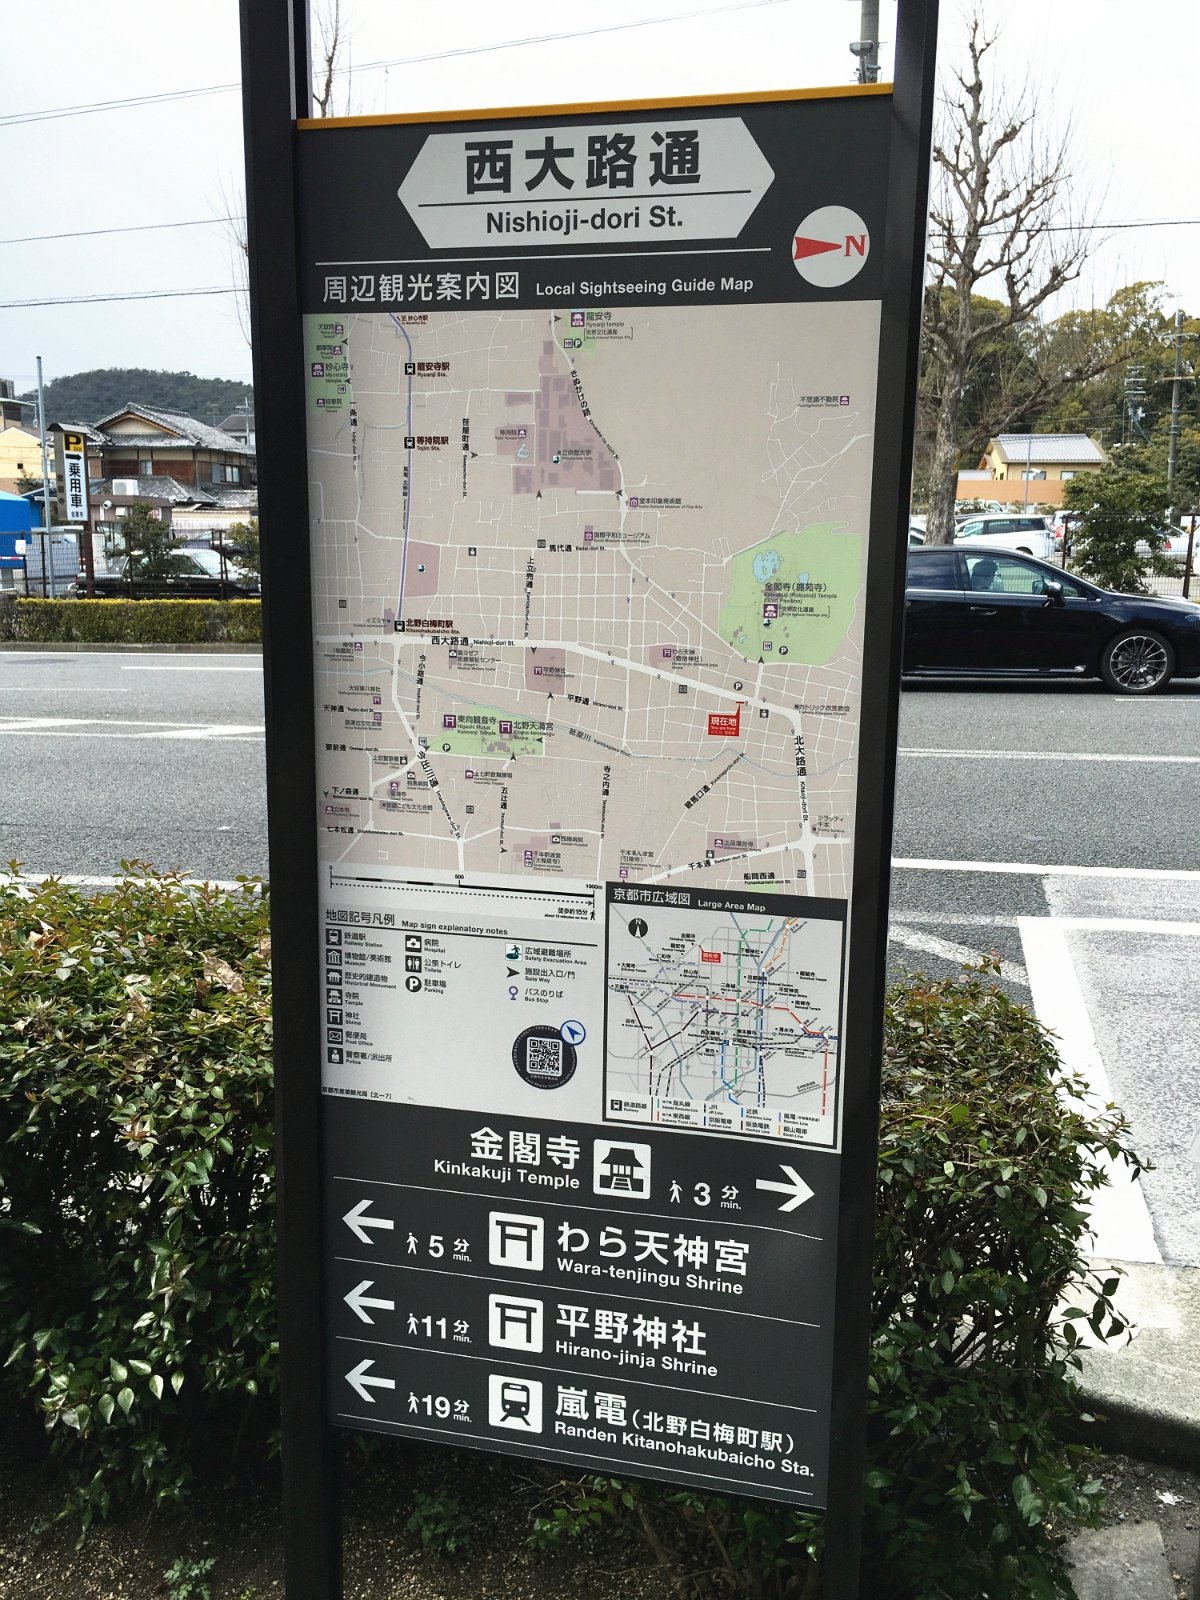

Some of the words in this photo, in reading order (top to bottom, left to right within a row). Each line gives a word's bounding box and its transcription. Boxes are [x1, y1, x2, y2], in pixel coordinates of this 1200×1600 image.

[464, 130, 702, 195] 西大路通
[486, 206, 640, 238] Nishioji-dori
[649, 205, 683, 228] St.
[844, 235, 866, 257] N
[323, 271, 520, 303] 周辺観光案内図
[536, 281, 575, 297] Local
[579, 279, 666, 297] Sightseeing
[671, 277, 715, 293] Guide
[720, 277, 753, 295] Map
[586, 312, 612, 321] 龍安寺
[326, 363, 348, 371] 妙心寺
[350, 402, 358, 426] 一条通
[64, 433, 81, 451] P
[416, 436, 449, 445] 等持院駅
[69, 462, 83, 508] 乗用車
[406, 619, 453, 628] 北野白梅町駅
[431, 636, 469, 646] 西大路通
[567, 694, 590, 706] 平野通
[457, 715, 496, 725] 東向観音寺
[513, 721, 554, 731] 北野天満宮
[711, 716, 737, 726] 現在地
[568, 727, 592, 743] 紙屋川
[794, 735, 807, 776] 北大路通
[417, 750, 439, 788] 今出川通
[601, 765, 611, 796] 寺之内通
[332, 786, 359, 795] 下ノ森通
[327, 826, 354, 834] 七本松通
[688, 859, 712, 870] 千本通
[744, 872, 775, 880] 船岡西通
[613, 888, 691, 906] 京都市広域図
[558, 907, 588, 916] 徒歩約15分
[697, 899, 722, 910] Large
[724, 901, 745, 910] Area
[747, 903, 766, 913] Map
[326, 909, 395, 926] 地図記号凡例
[401, 920, 419, 928] Map
[420, 921, 437, 930] sign
[438, 922, 484, 934] explanatory
[344, 932, 366, 940] 鉄道駅
[424, 939, 439, 947] 病院
[344, 952, 392, 963] 博物館/美術館
[525, 947, 572, 958] 広域避難場所
[424, 959, 461, 969] 公衆トイレ
[525, 955, 542, 963] Safety
[344, 972, 388, 983] 歴史的建造物
[525, 967, 576, 979] 施設出入口/門
[424, 979, 447, 988] 駐車場
[345, 992, 360, 1000] 寺院
[525, 988, 564, 998] バスのりば
[345, 1011, 360, 1020] 神社
[345, 1031, 367, 1040] 郵便局
[346, 1051, 392, 1062] 警察署/派出所
[470, 1126, 580, 1170] 金閣寺
[434, 1159, 512, 1183] Kinkakuji
[517, 1168, 580, 1190] Temple
[693, 1182, 711, 1206] 3
[721, 1185, 739, 1199] 分
[721, 1199, 742, 1211] min.
[428, 1235, 444, 1258] 5
[453, 1238, 471, 1252] 分
[557, 1221, 750, 1276] わら天神宮
[453, 1251, 472, 1263] min.
[557, 1258, 681, 1289] Wara-tenjingu
[686, 1273, 744, 1295] Shrine
[421, 1315, 448, 1339] 11
[454, 1319, 471, 1335] 分
[555, 1303, 707, 1356] 平野神社
[453, 1333, 472, 1344] min.
[555, 1340, 656, 1370] Hirano-jinja
[661, 1355, 718, 1377] Shrine
[421, 1394, 450, 1419] 19
[454, 1399, 471, 1414] 分
[453, 1412, 472, 1424] min.
[555, 1421, 618, 1445] Randen
[622, 1428, 777, 1472] Kitanohakubaicho
[781, 1457, 815, 1478] Sta.
